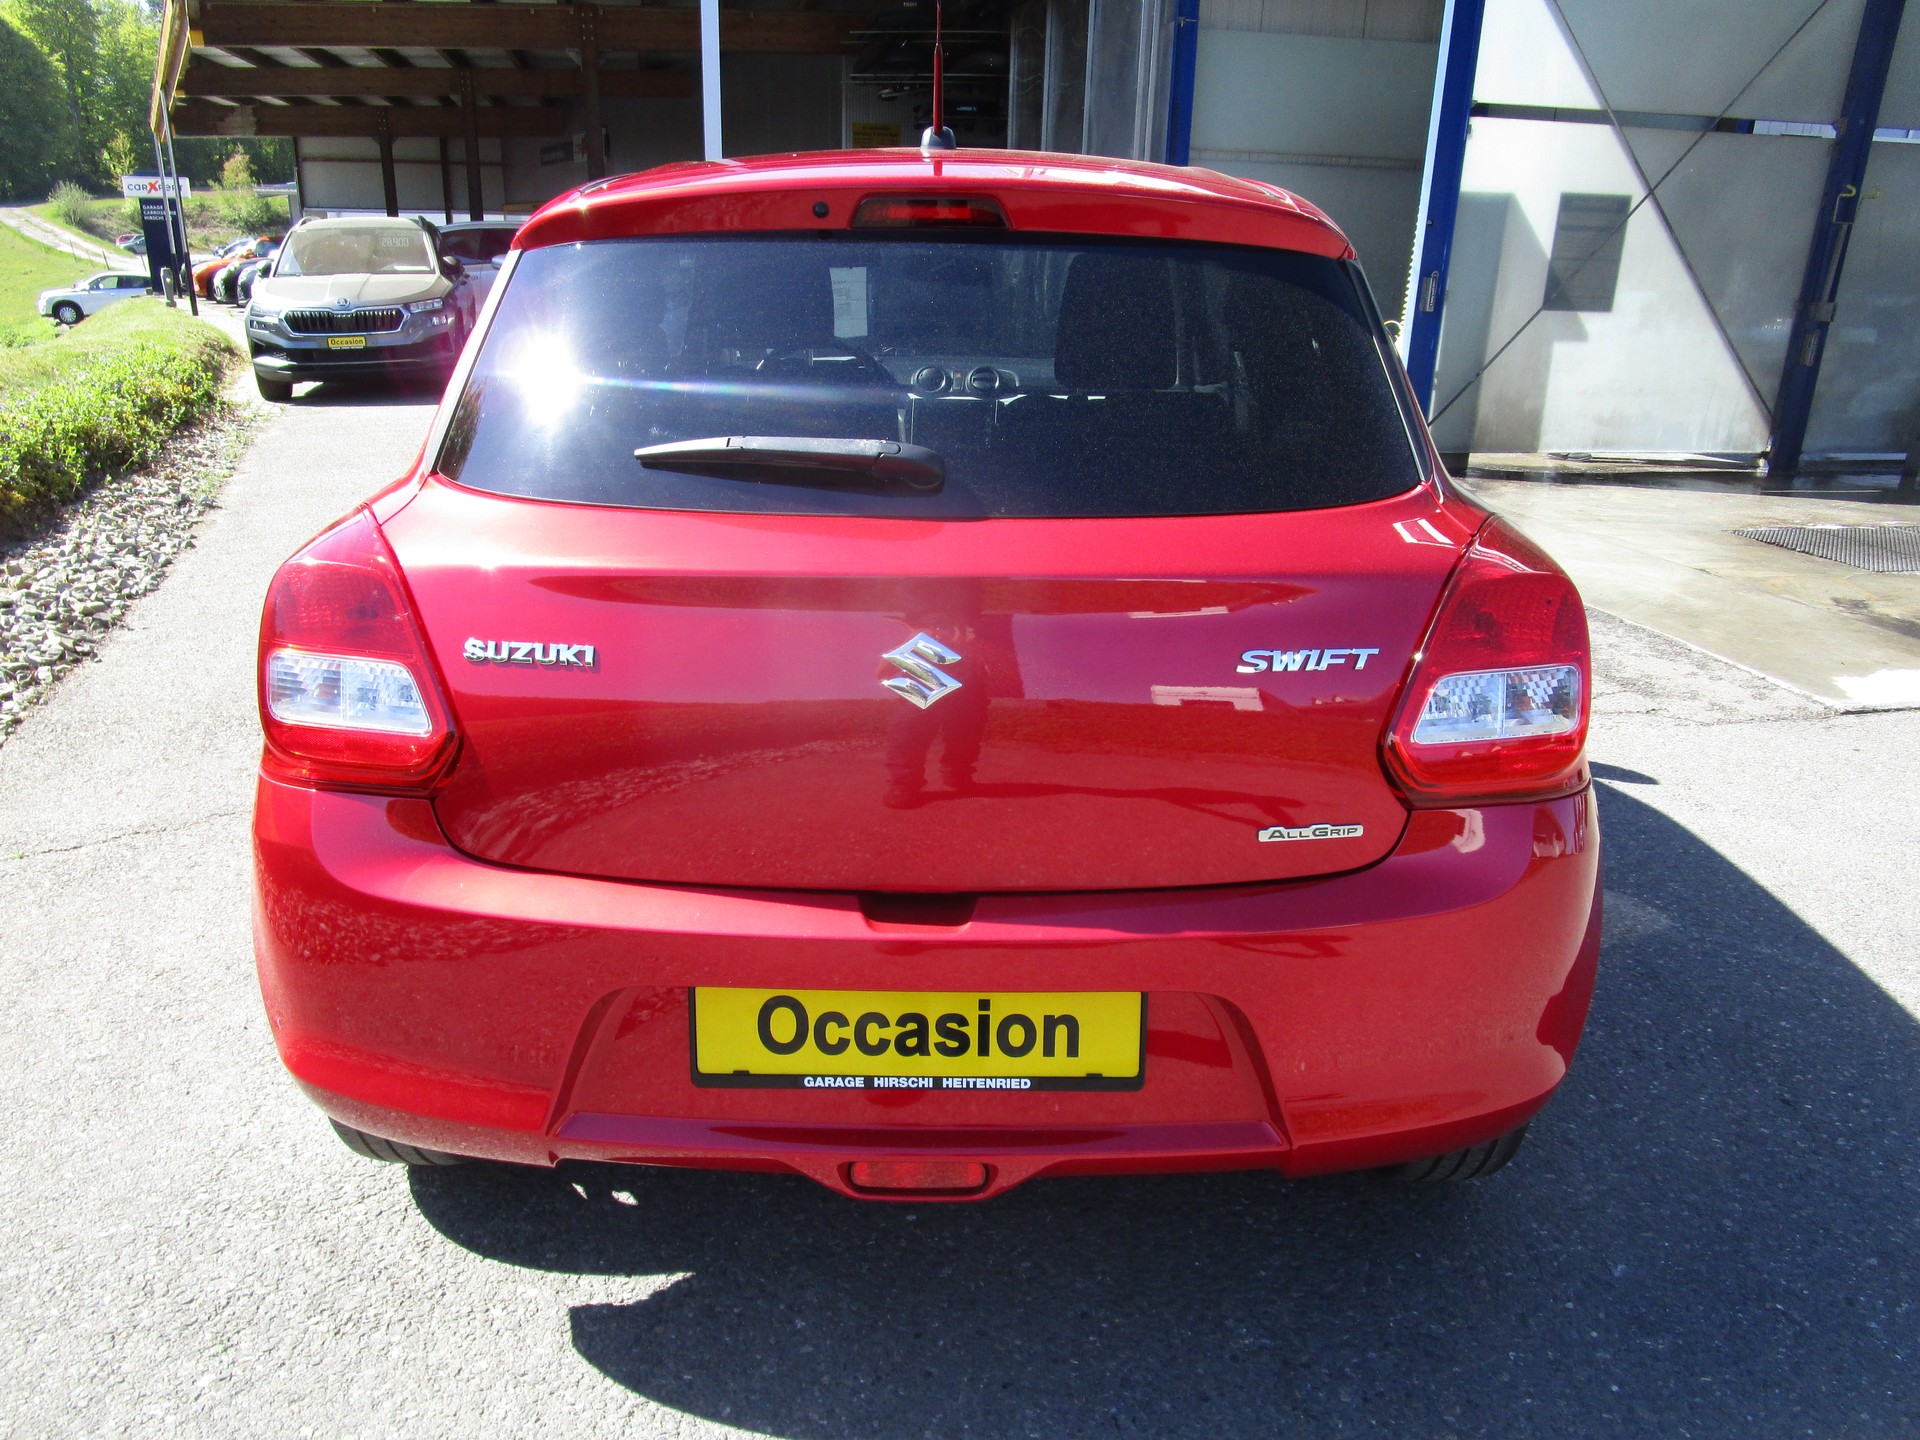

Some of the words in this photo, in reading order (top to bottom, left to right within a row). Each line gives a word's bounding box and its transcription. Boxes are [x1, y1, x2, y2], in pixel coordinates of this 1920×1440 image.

[330, 338, 364, 346] Occasion
[463, 637, 595, 666] SUZUKI
[1236, 648, 1379, 673] SWIFT
[757, 995, 1080, 1058] Occasion
[803, 1076, 865, 1088] GARAGE
[873, 1076, 934, 1089] HIRSCHI
[942, 1077, 1032, 1089] HEITENRIED
